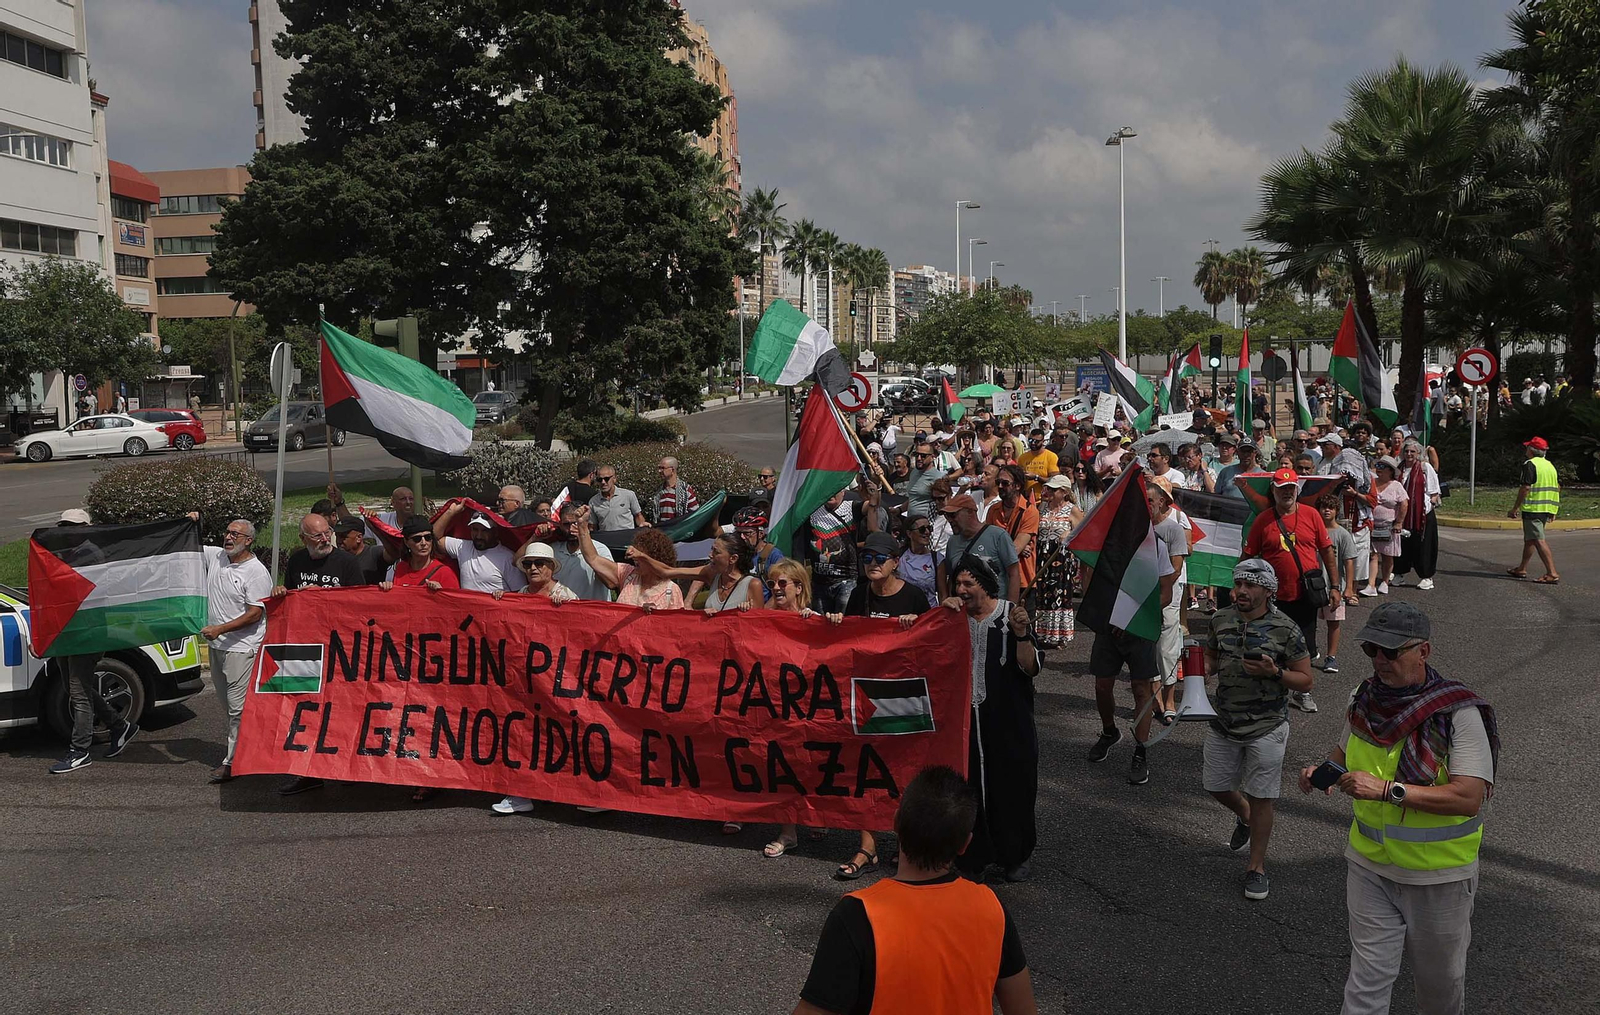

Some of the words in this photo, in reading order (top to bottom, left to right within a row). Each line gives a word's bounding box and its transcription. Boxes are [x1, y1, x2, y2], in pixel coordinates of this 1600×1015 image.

[321, 575, 331, 583] ES
[526, 641, 691, 713] PUERTO
[713, 658, 844, 721] PARA
[283, 701, 339, 755] EL
[356, 702, 613, 782] GENOCIDIO
[640, 728, 701, 789] EN
[724, 737, 901, 799] GAZA
